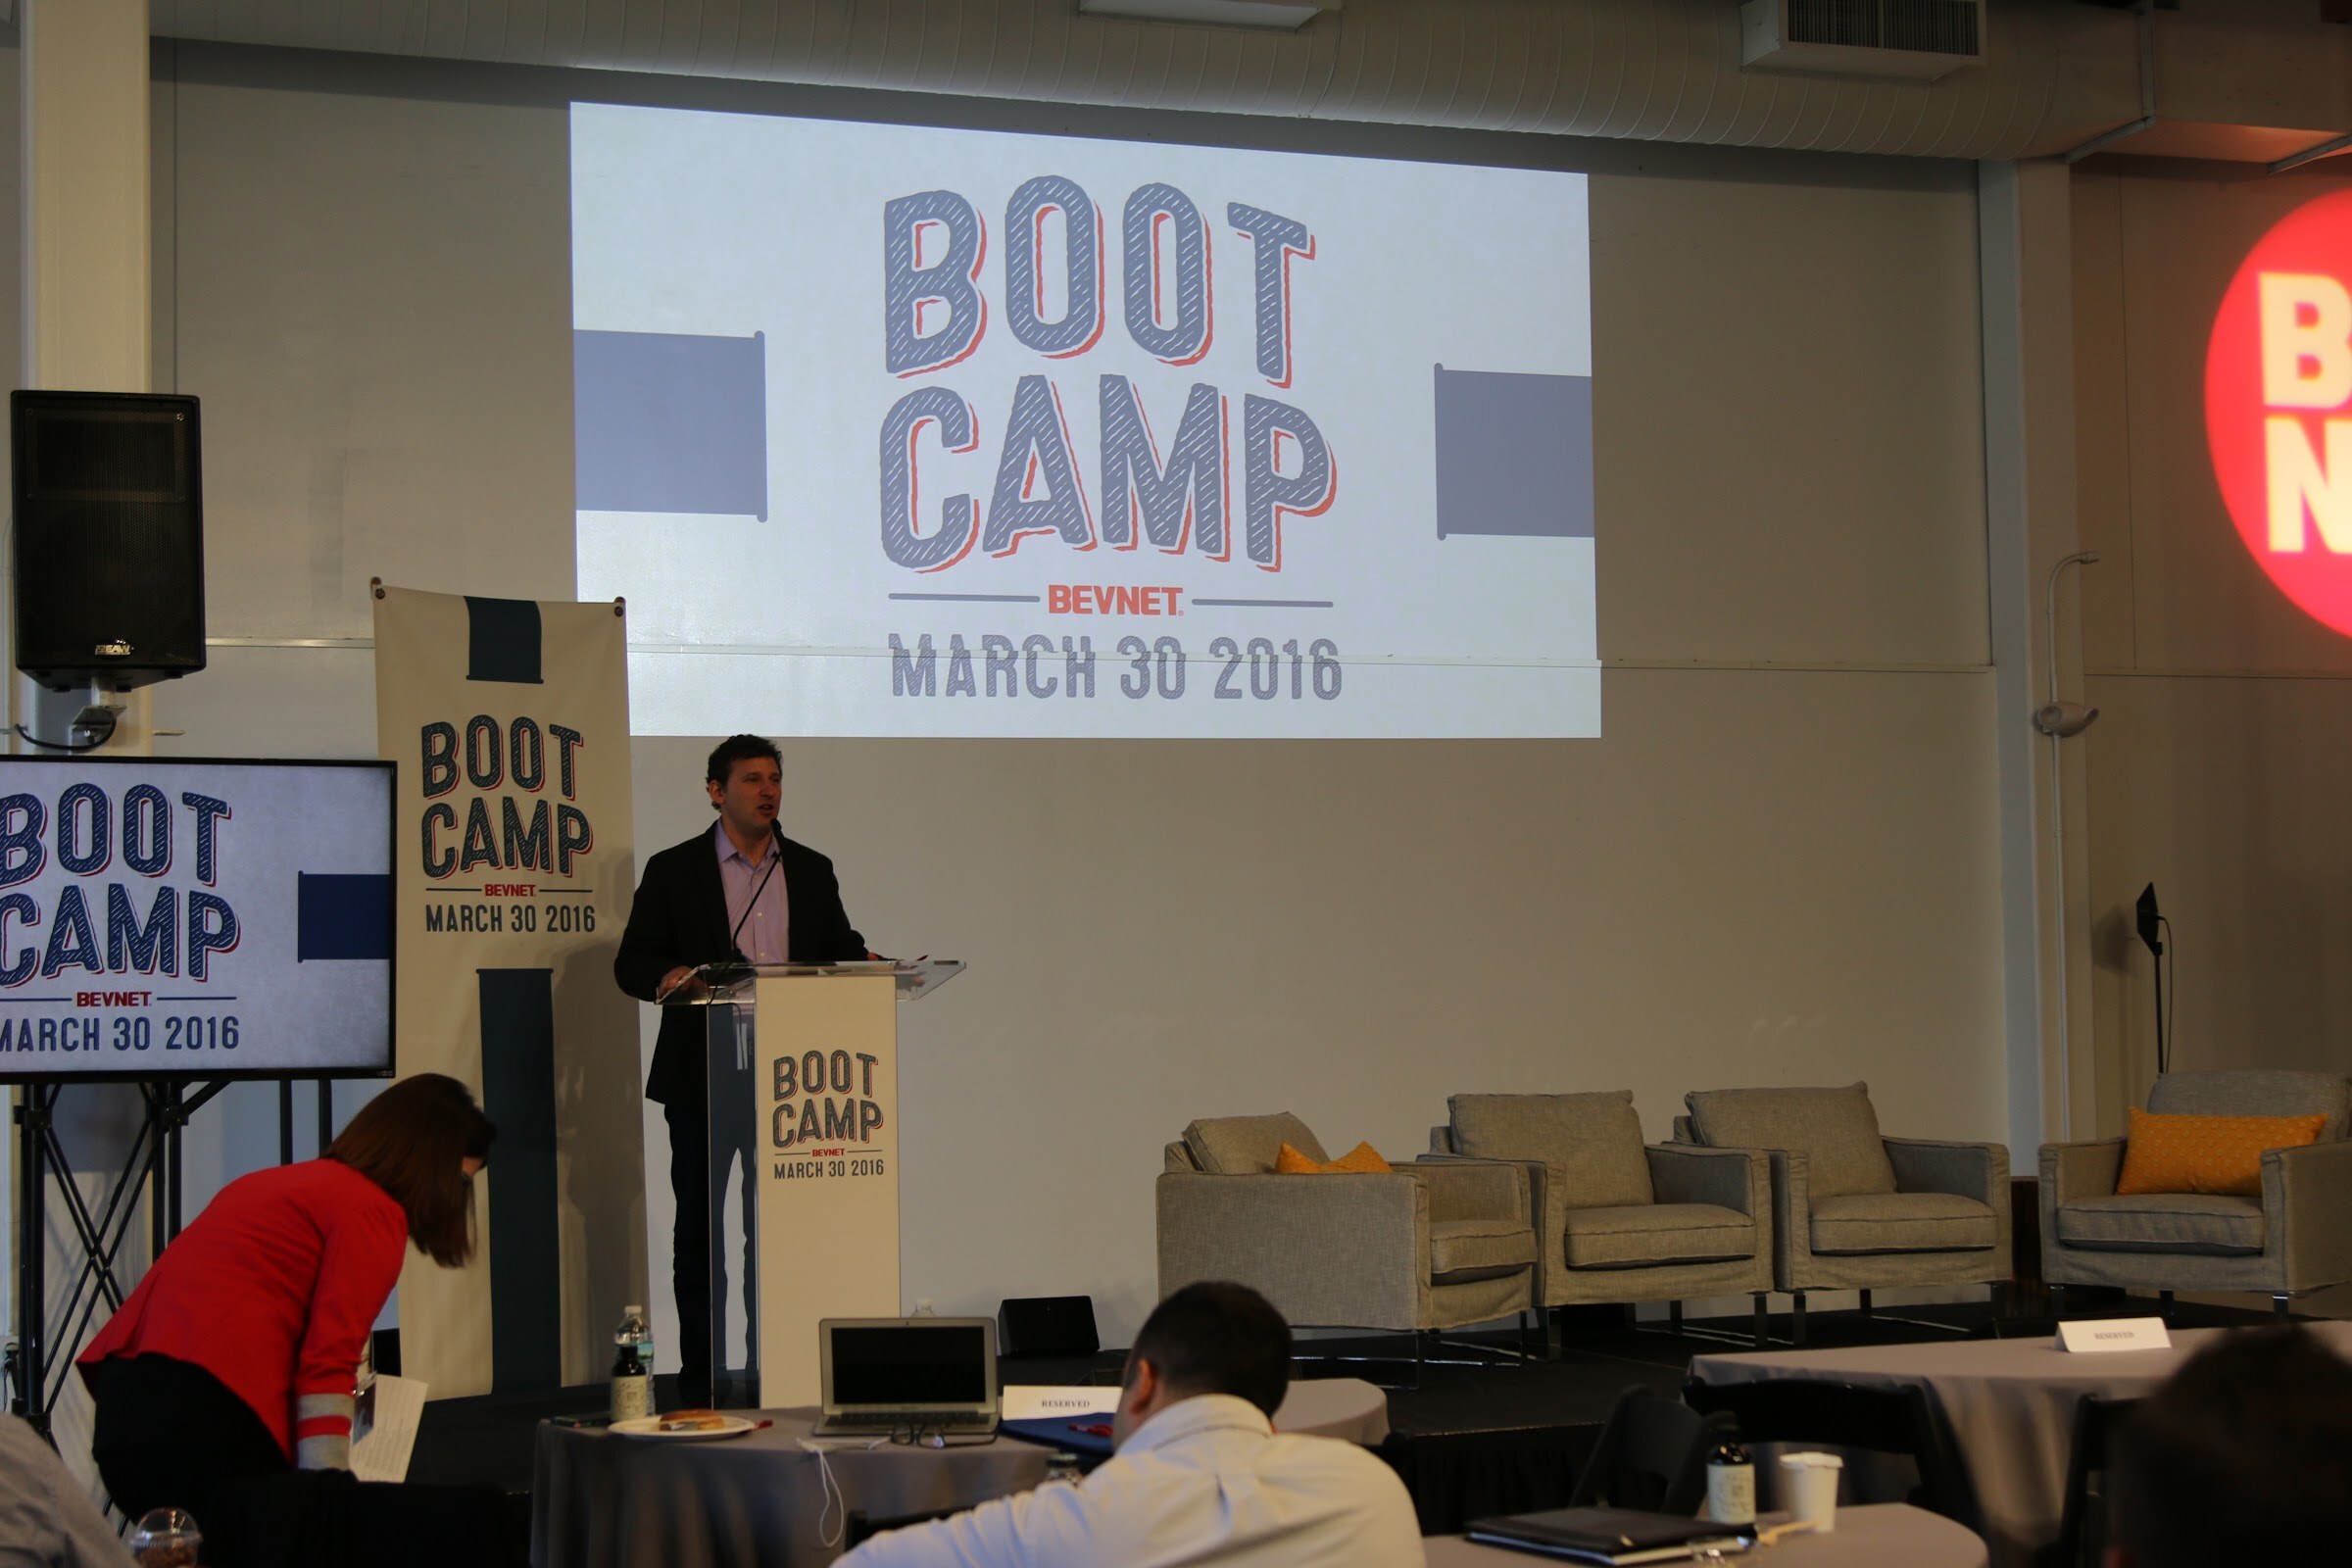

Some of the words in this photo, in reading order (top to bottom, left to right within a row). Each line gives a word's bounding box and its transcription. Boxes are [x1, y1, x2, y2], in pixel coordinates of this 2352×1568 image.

[884, 174, 1316, 389] BOOT
[879, 373, 1338, 573] CAMP
[1048, 584, 1184, 615] BEVNET
[888, 633, 1096, 698] MARCH
[1117, 635, 1186, 700] 30
[1210, 636, 1343, 701] 2016
[421, 714, 584, 802] BOOT
[0, 782, 232, 890] BOOT
[421, 796, 594, 880] CAMP
[484, 884, 537, 897] BEVNET
[0, 883, 242, 988] CAMP
[425, 904, 502, 932] MARCH
[511, 905, 536, 932] 30
[546, 905, 596, 933] 2016
[76, 992, 152, 1007] BEVNET
[113, 1016, 151, 1051] 30
[166, 1015, 239, 1050] 2016
[773, 1050, 878, 1102] BOOT
[772, 1098, 884, 1149] CAMP
[774, 1161, 823, 1179] MARCH
[828, 1160, 845, 1177] 30
[851, 1159, 884, 1176] 2016
[811, 1149, 846, 1157] BEVNET
[1041, 1399, 1090, 1408] RESERVED
